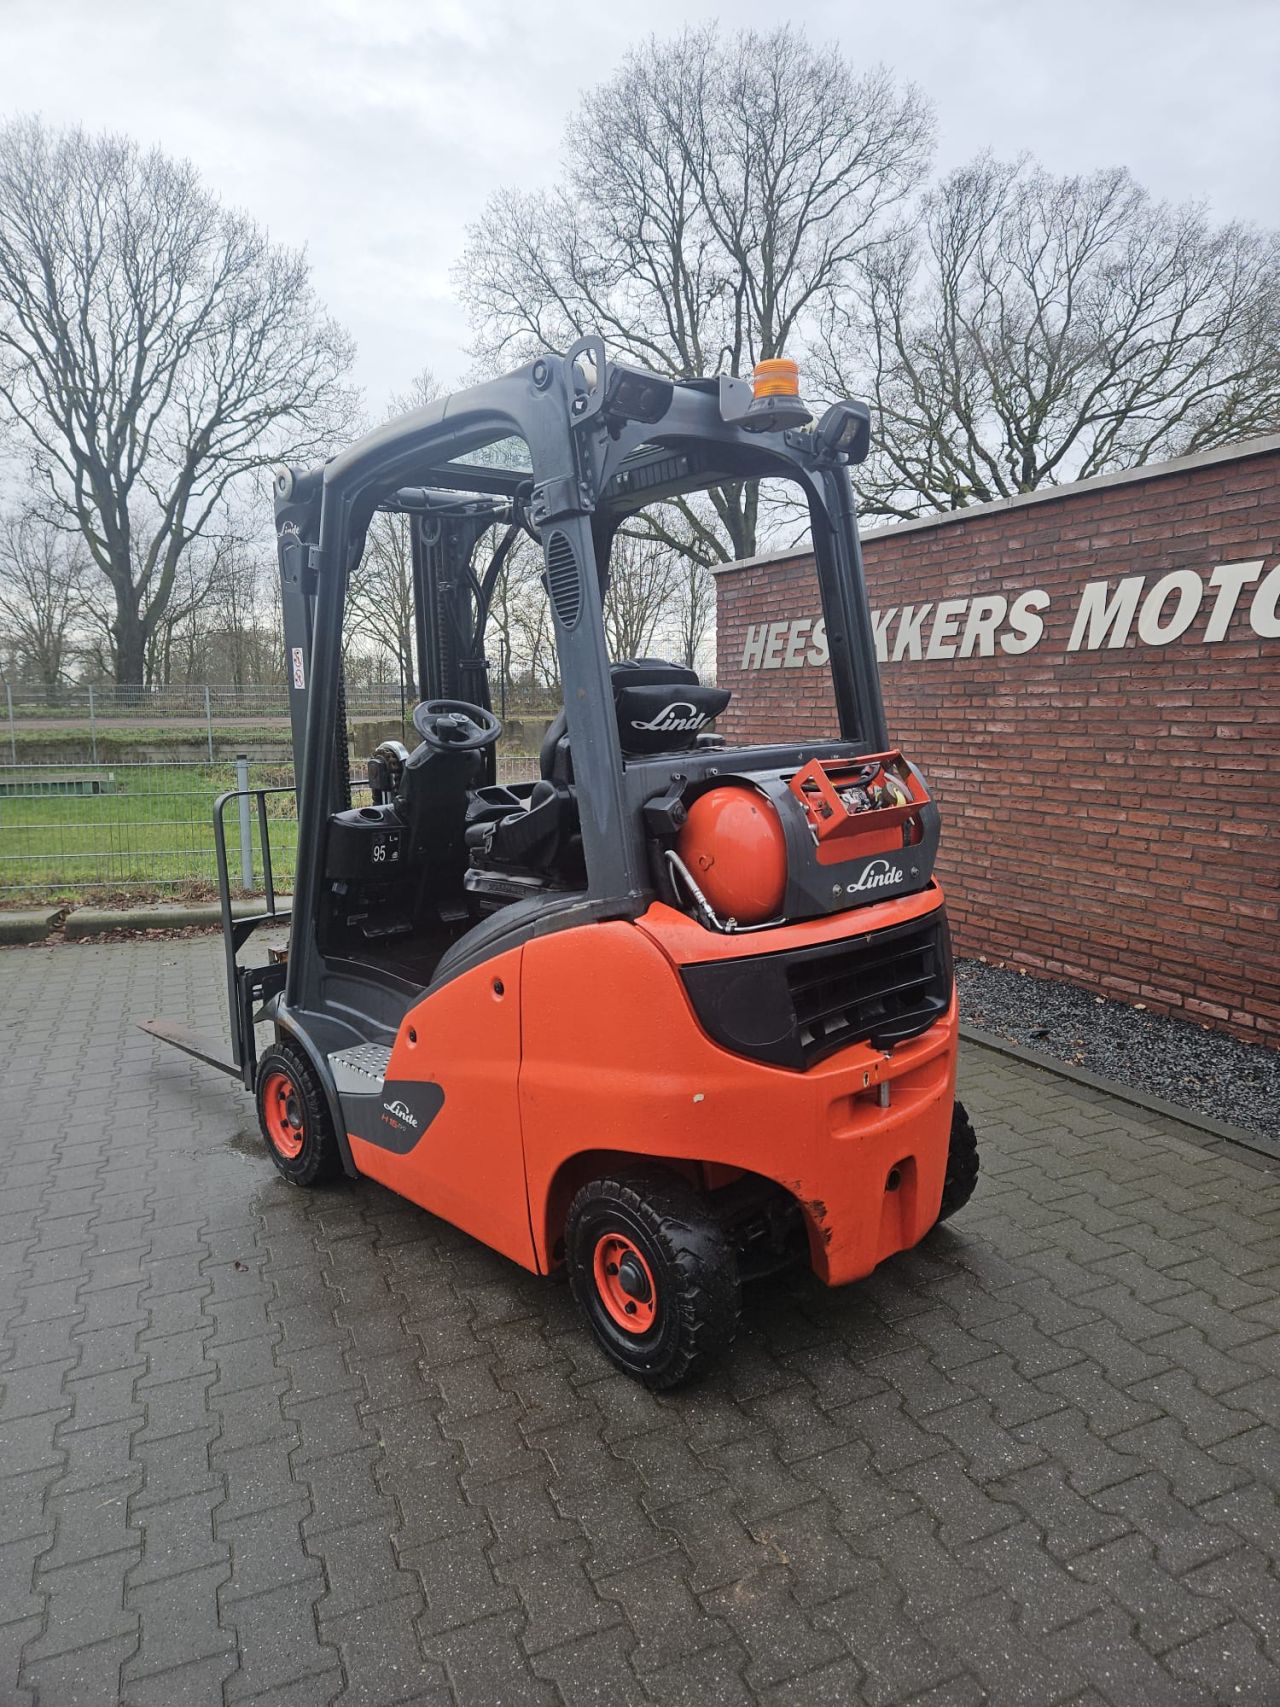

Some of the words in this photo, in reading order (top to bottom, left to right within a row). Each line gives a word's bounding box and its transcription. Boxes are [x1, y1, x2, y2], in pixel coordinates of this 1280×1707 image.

[741, 589, 1051, 670] HEESKKERS
[373, 845, 386, 862] 95
[846, 859, 903, 893] Linde
[383, 1100, 418, 1128] Linde
